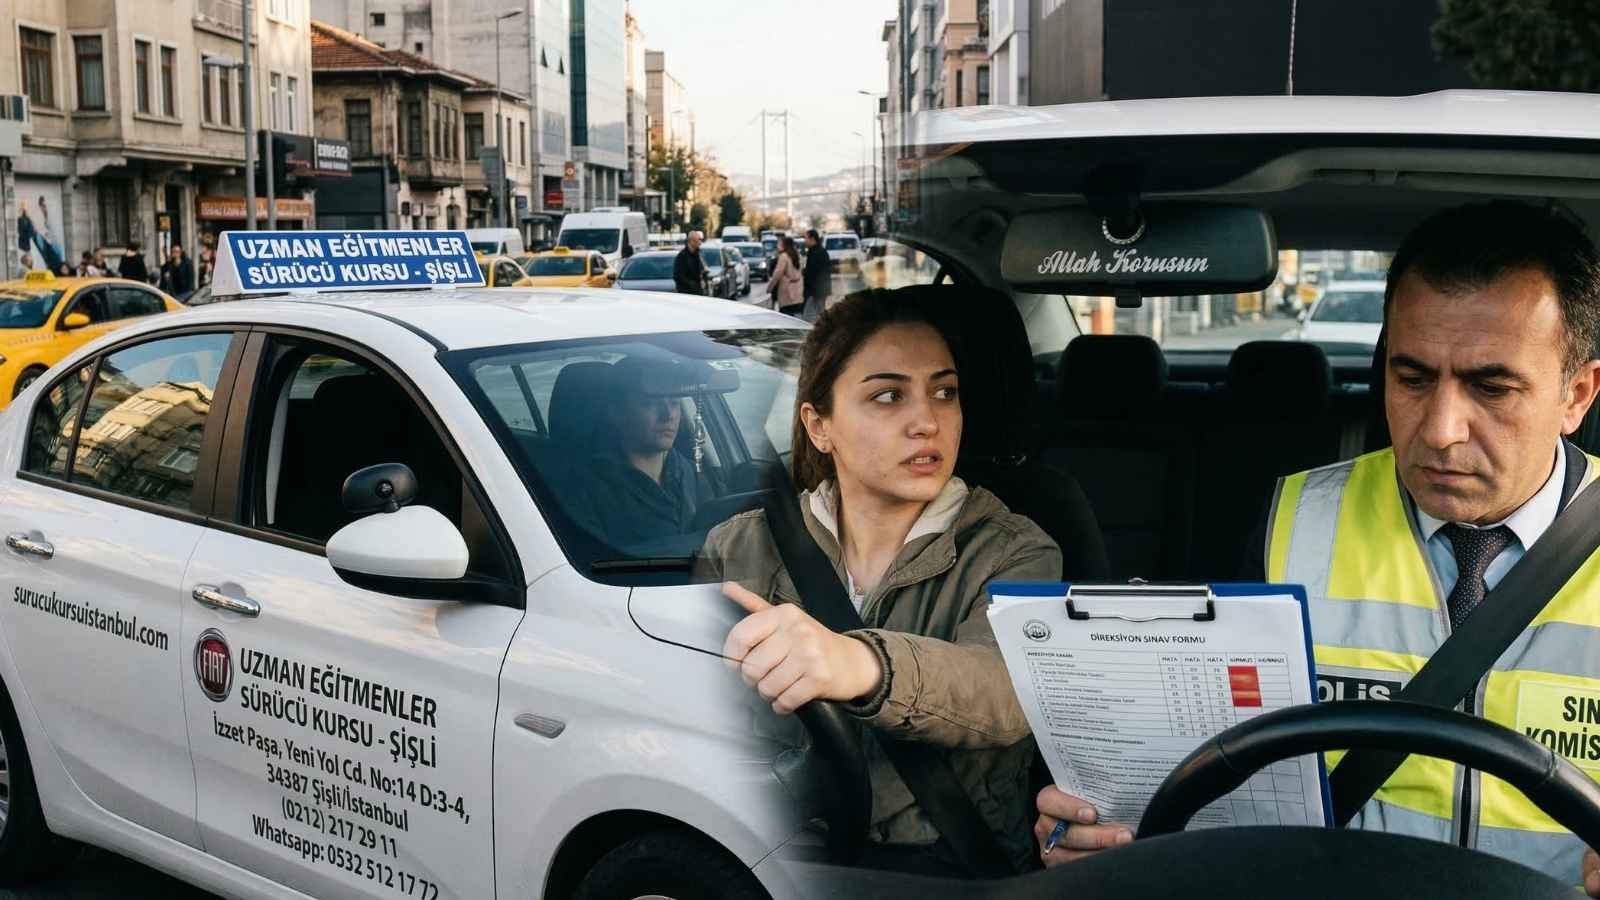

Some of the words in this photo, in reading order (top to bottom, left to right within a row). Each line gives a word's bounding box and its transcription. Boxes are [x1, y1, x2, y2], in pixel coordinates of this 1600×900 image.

[238, 238, 325, 259] UZMAN
[331, 234, 467, 258] EĞİTMENLER
[248, 262, 336, 285] SÜRÜCÜ
[341, 263, 409, 283] KURSU
[426, 258, 473, 283] ŞİŞLİ
[1037, 250, 1101, 275] Allah
[1105, 248, 1208, 274] Korusun
[14, 586, 169, 650] surucukursuistanbul.com
[1172, 635, 1206, 644] FORMU
[202, 647, 227, 685] FIAT
[240, 647, 305, 690] UZMAN
[310, 663, 437, 728] EĞİTMENLER
[240, 682, 308, 727] SÜRÜCÜ
[312, 706, 373, 747] KURSU
[389, 726, 437, 769] ŞİŞLİ
[213, 711, 245, 745] İzzet
[248, 726, 282, 759] Paşa,
[285, 738, 315, 767] Yeni
[316, 750, 339, 776] Yol
[343, 759, 367, 785] Cd.
[370, 767, 417, 802] No:14
[420, 784, 470, 825] D:3-4,
[267, 763, 308, 794] 34387
[312, 780, 409, 832] Şişli/İstanbul
[252, 814, 325, 862] Whatsapp:
[327, 844, 362, 876] 0532
[366, 859, 394, 888] 512
[398, 871, 416, 897] 17
[419, 878, 439, 900] 72
[282, 796, 325, 834] (0212)
[328, 815, 354, 841] 217
[358, 826, 376, 849] 29
[380, 834, 397, 858] 11
